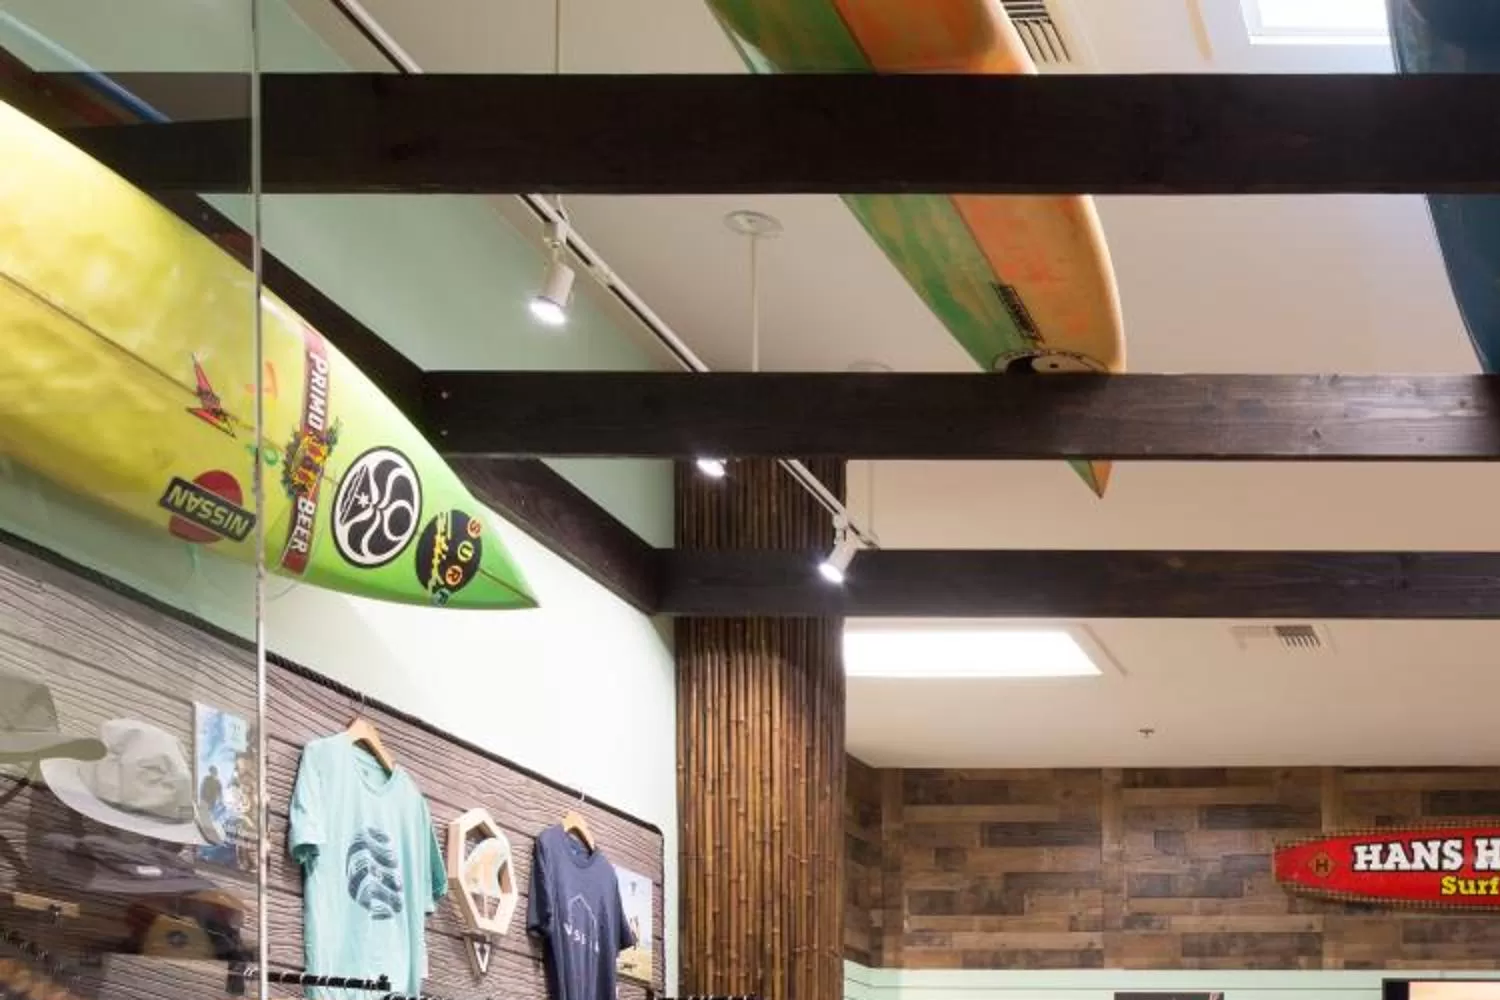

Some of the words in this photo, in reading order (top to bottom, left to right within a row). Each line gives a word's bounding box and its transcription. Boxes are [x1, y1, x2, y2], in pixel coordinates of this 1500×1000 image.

[308, 351, 328, 431] PRIMO
[167, 484, 250, 536] NISSAN
[290, 496, 316, 554] BEER
[1353, 838, 1465, 871] HANS
[1441, 875, 1500, 896] Surf
